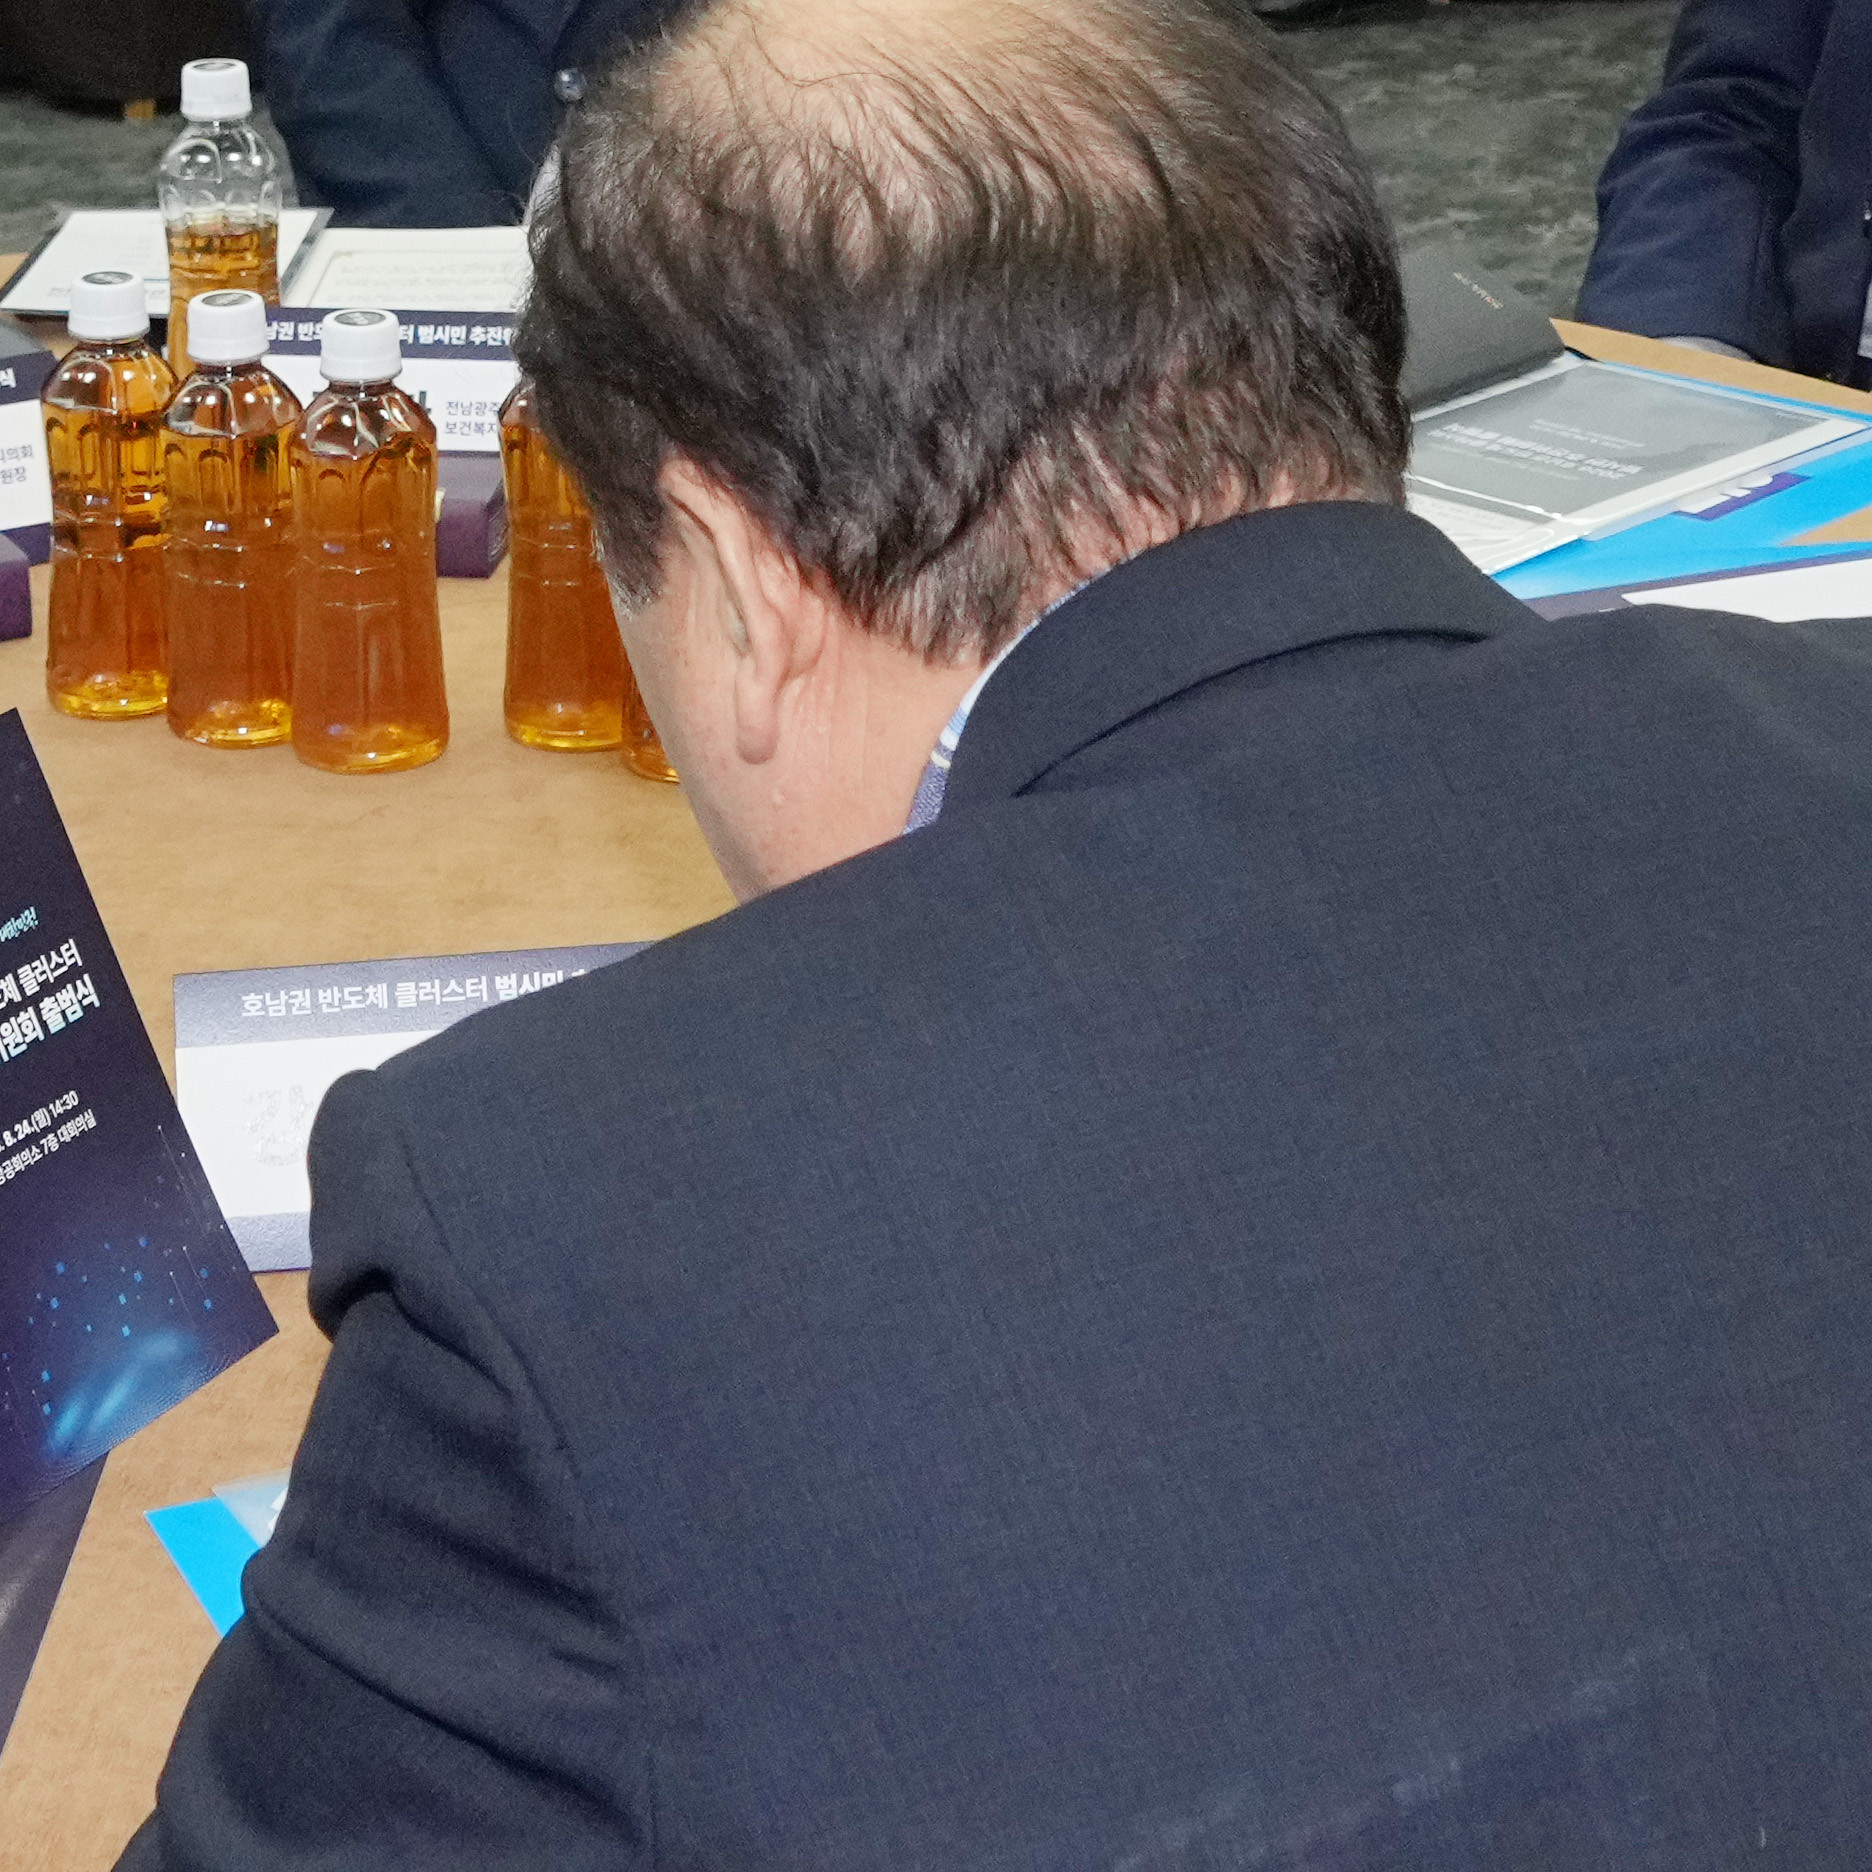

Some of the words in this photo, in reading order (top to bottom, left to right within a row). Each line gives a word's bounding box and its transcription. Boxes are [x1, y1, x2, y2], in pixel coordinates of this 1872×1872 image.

[266, 321, 294, 341] 남권
[417, 325, 466, 345] 범시민
[17, 938, 83, 997] 클러스터
[39, 973, 101, 1035] 출범식
[241, 990, 312, 1018] 호남권
[317, 984, 389, 1013] 반도체
[394, 974, 488, 1008] 클러스터
[14, 1108, 51, 1141] 24.(월)
[49, 1090, 79, 1120] 14:30
[42, 1133, 60, 1156] 7층
[56, 1108, 98, 1146] 대회의실
